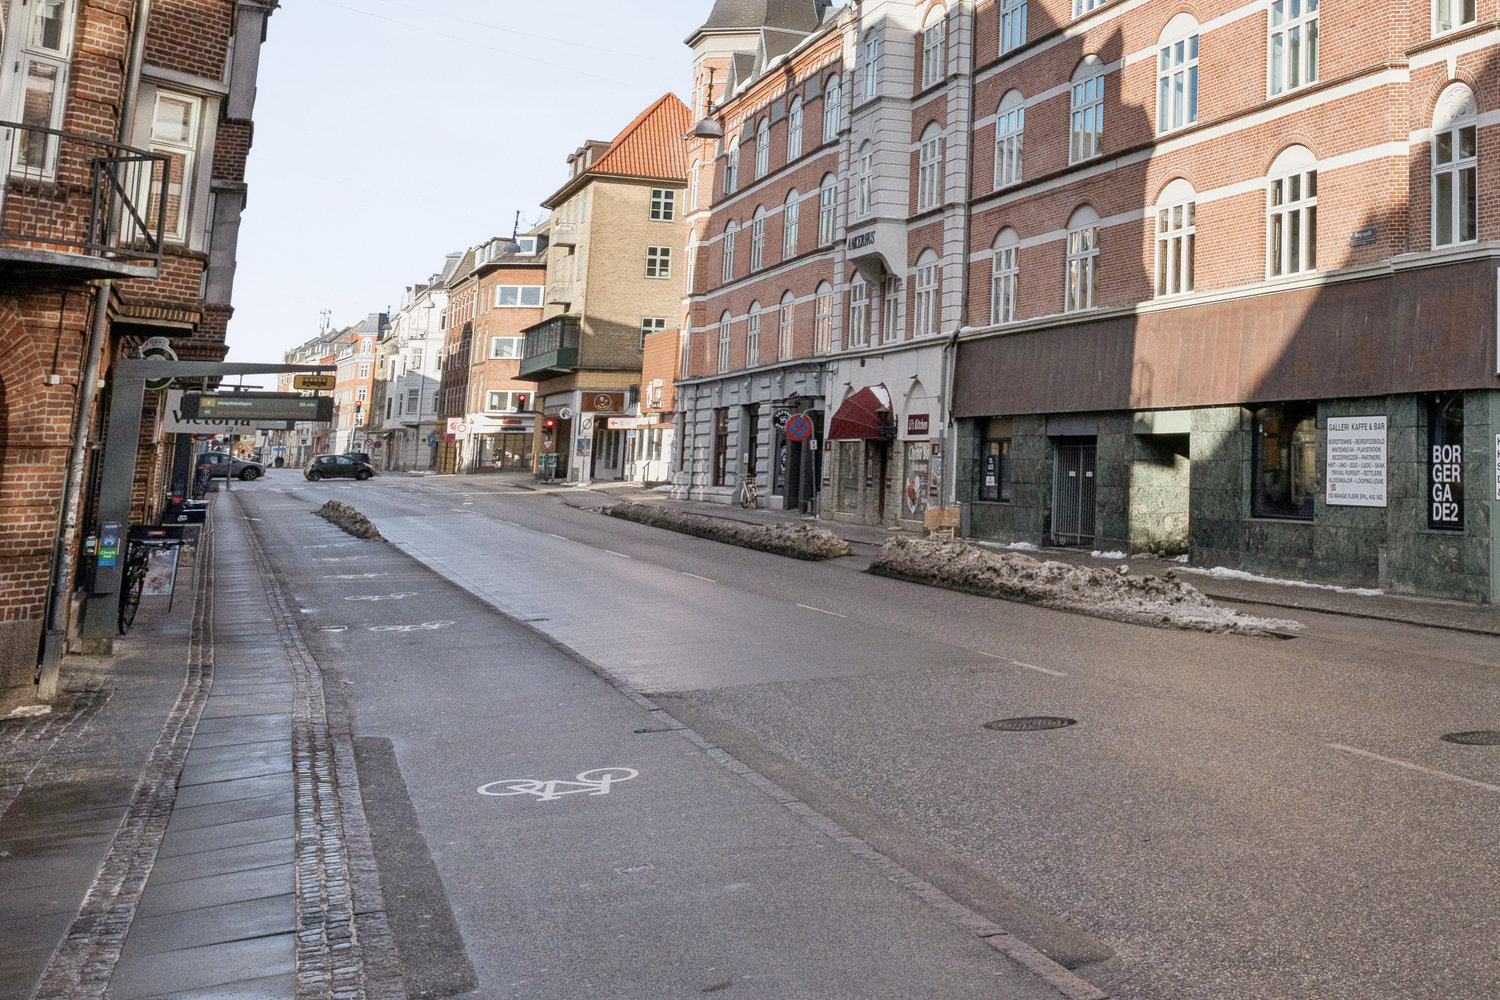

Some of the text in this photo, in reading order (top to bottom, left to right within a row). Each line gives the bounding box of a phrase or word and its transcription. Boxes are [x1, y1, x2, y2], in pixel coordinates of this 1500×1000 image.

[1351, 423, 1368, 431] KAFFE
[1374, 422, 1385, 430] BAR
[1432, 445, 1461, 463] BOR
[1432, 464, 1461, 482] GER
[1432, 483, 1452, 502] GA
[1432, 502, 1459, 521] DE2
